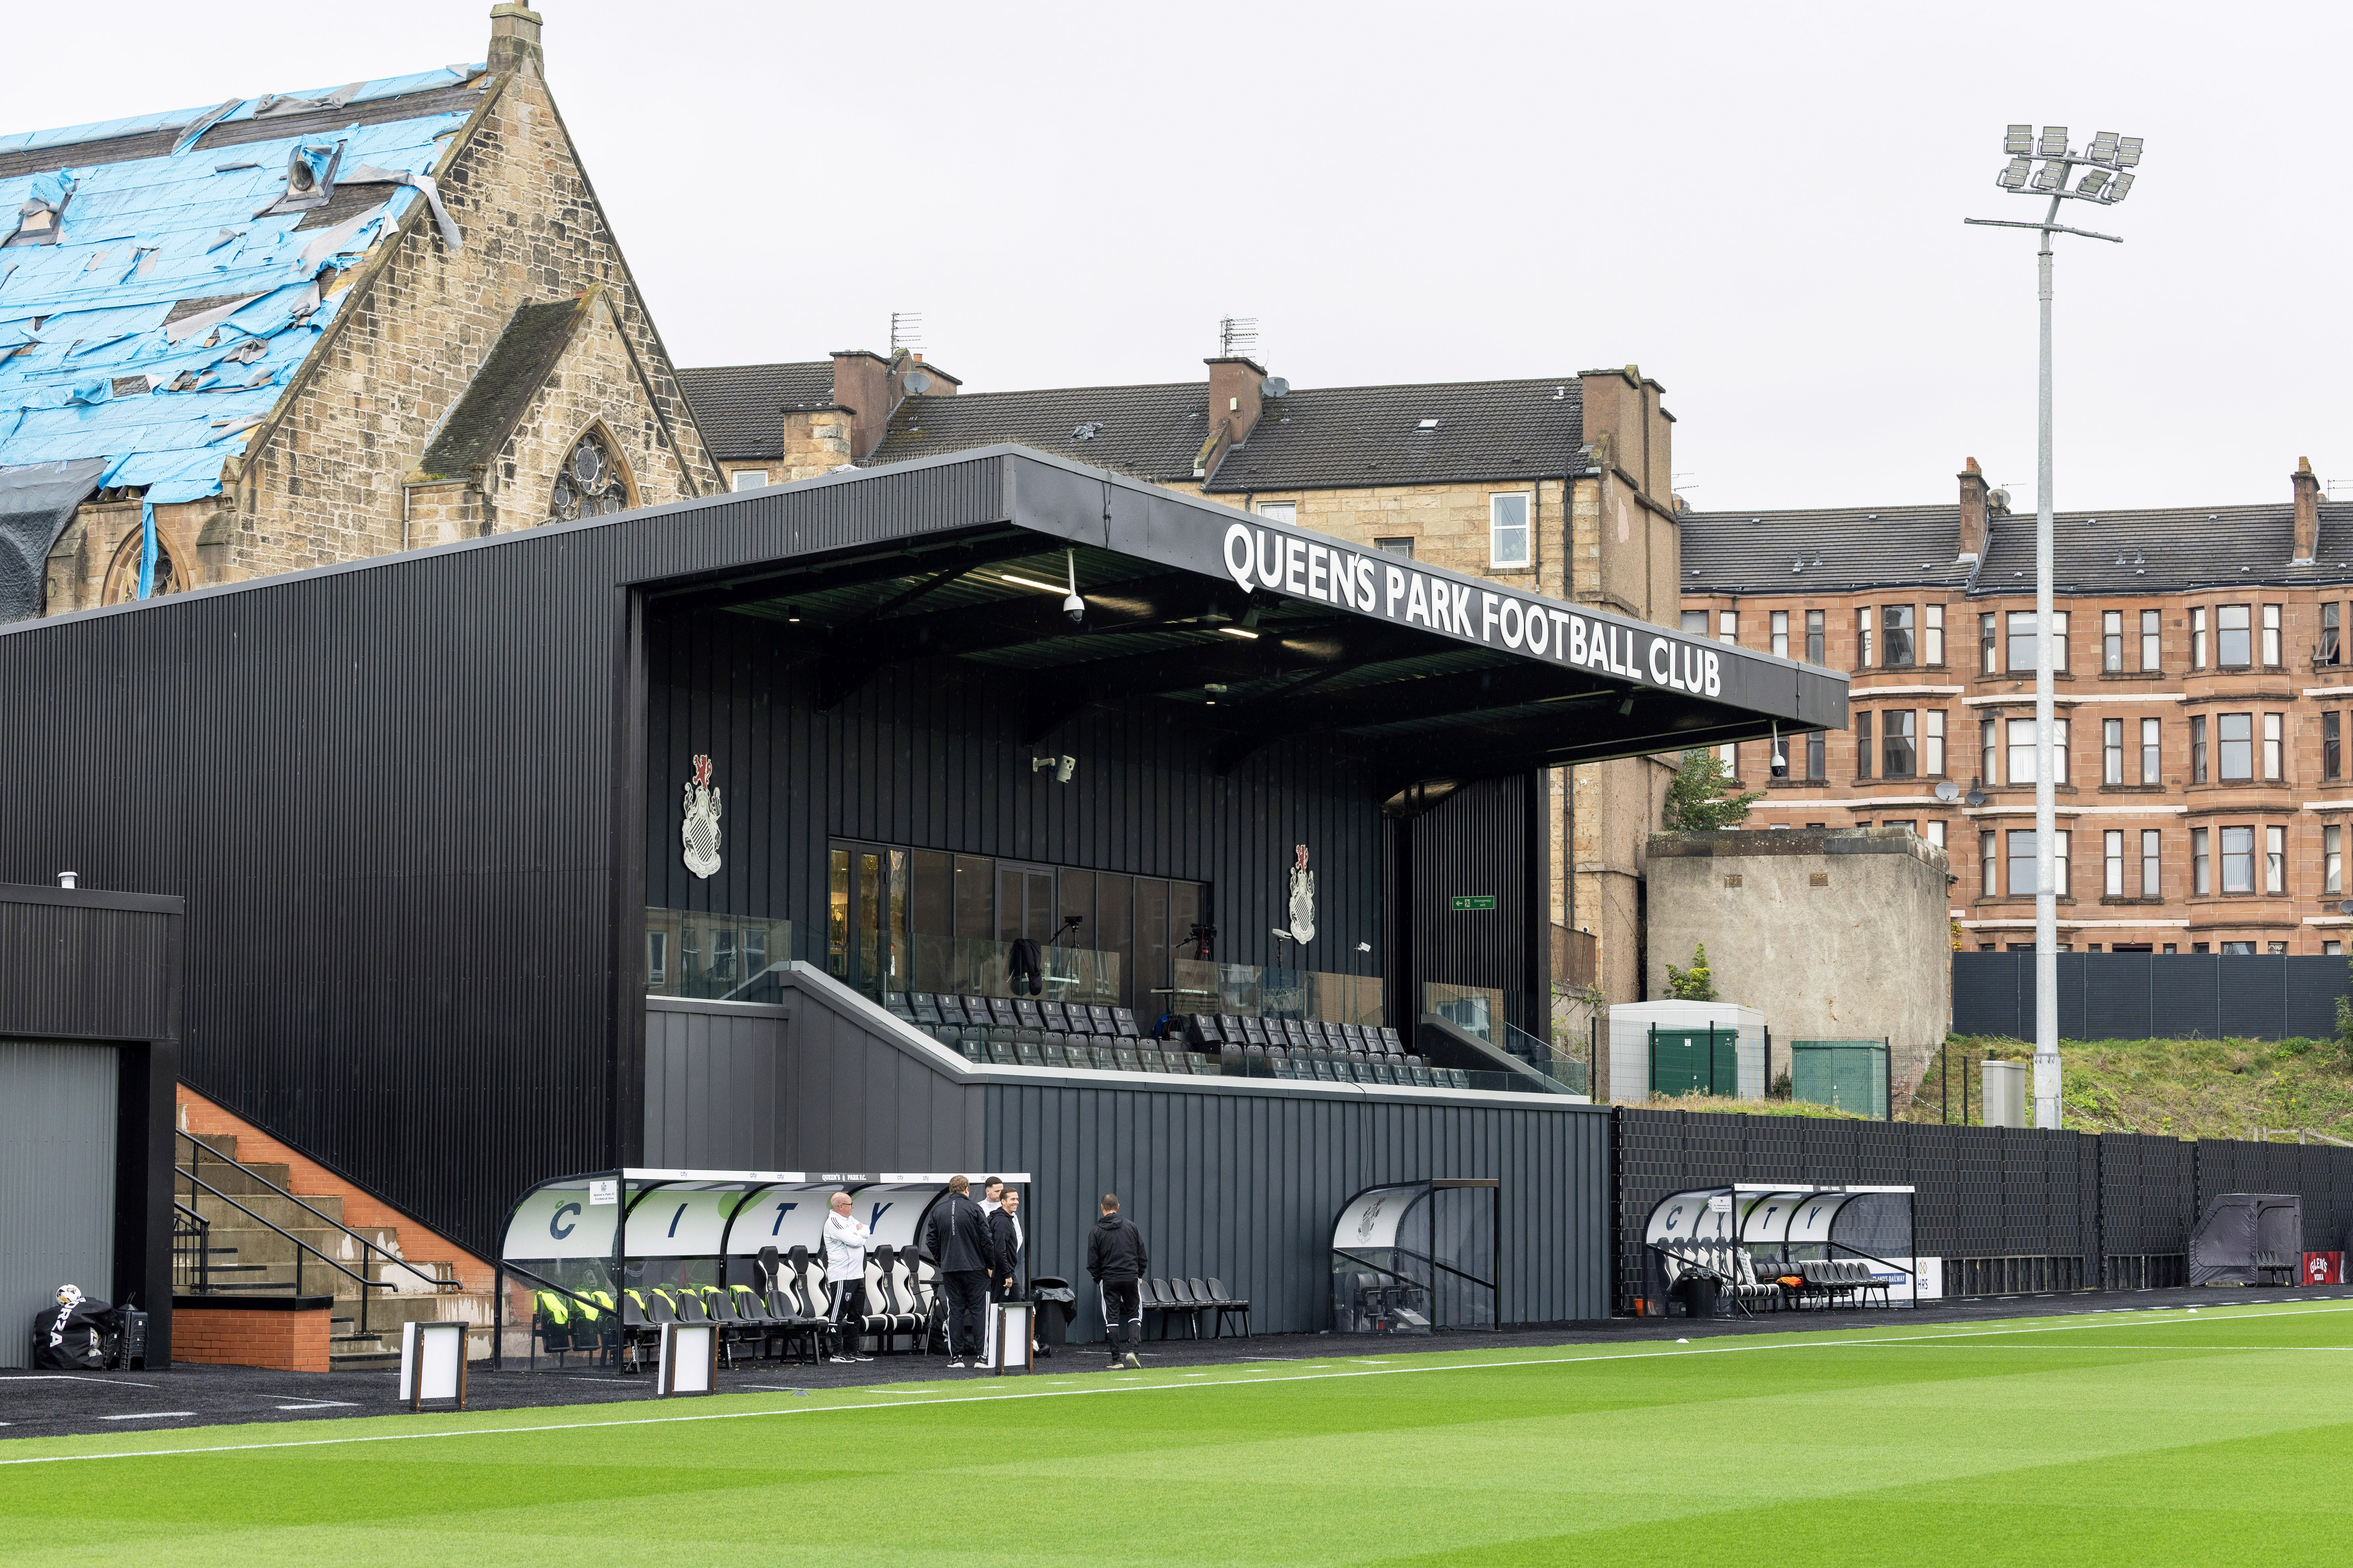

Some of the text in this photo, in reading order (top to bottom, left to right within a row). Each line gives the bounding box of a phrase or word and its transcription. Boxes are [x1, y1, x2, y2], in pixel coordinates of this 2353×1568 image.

[1224, 523, 1720, 698] QUEEN'S PARK FOOTBALL CLUB
[2310, 1257, 2327, 1274] GLEN'S
[1918, 1278, 1928, 1290] HRS
